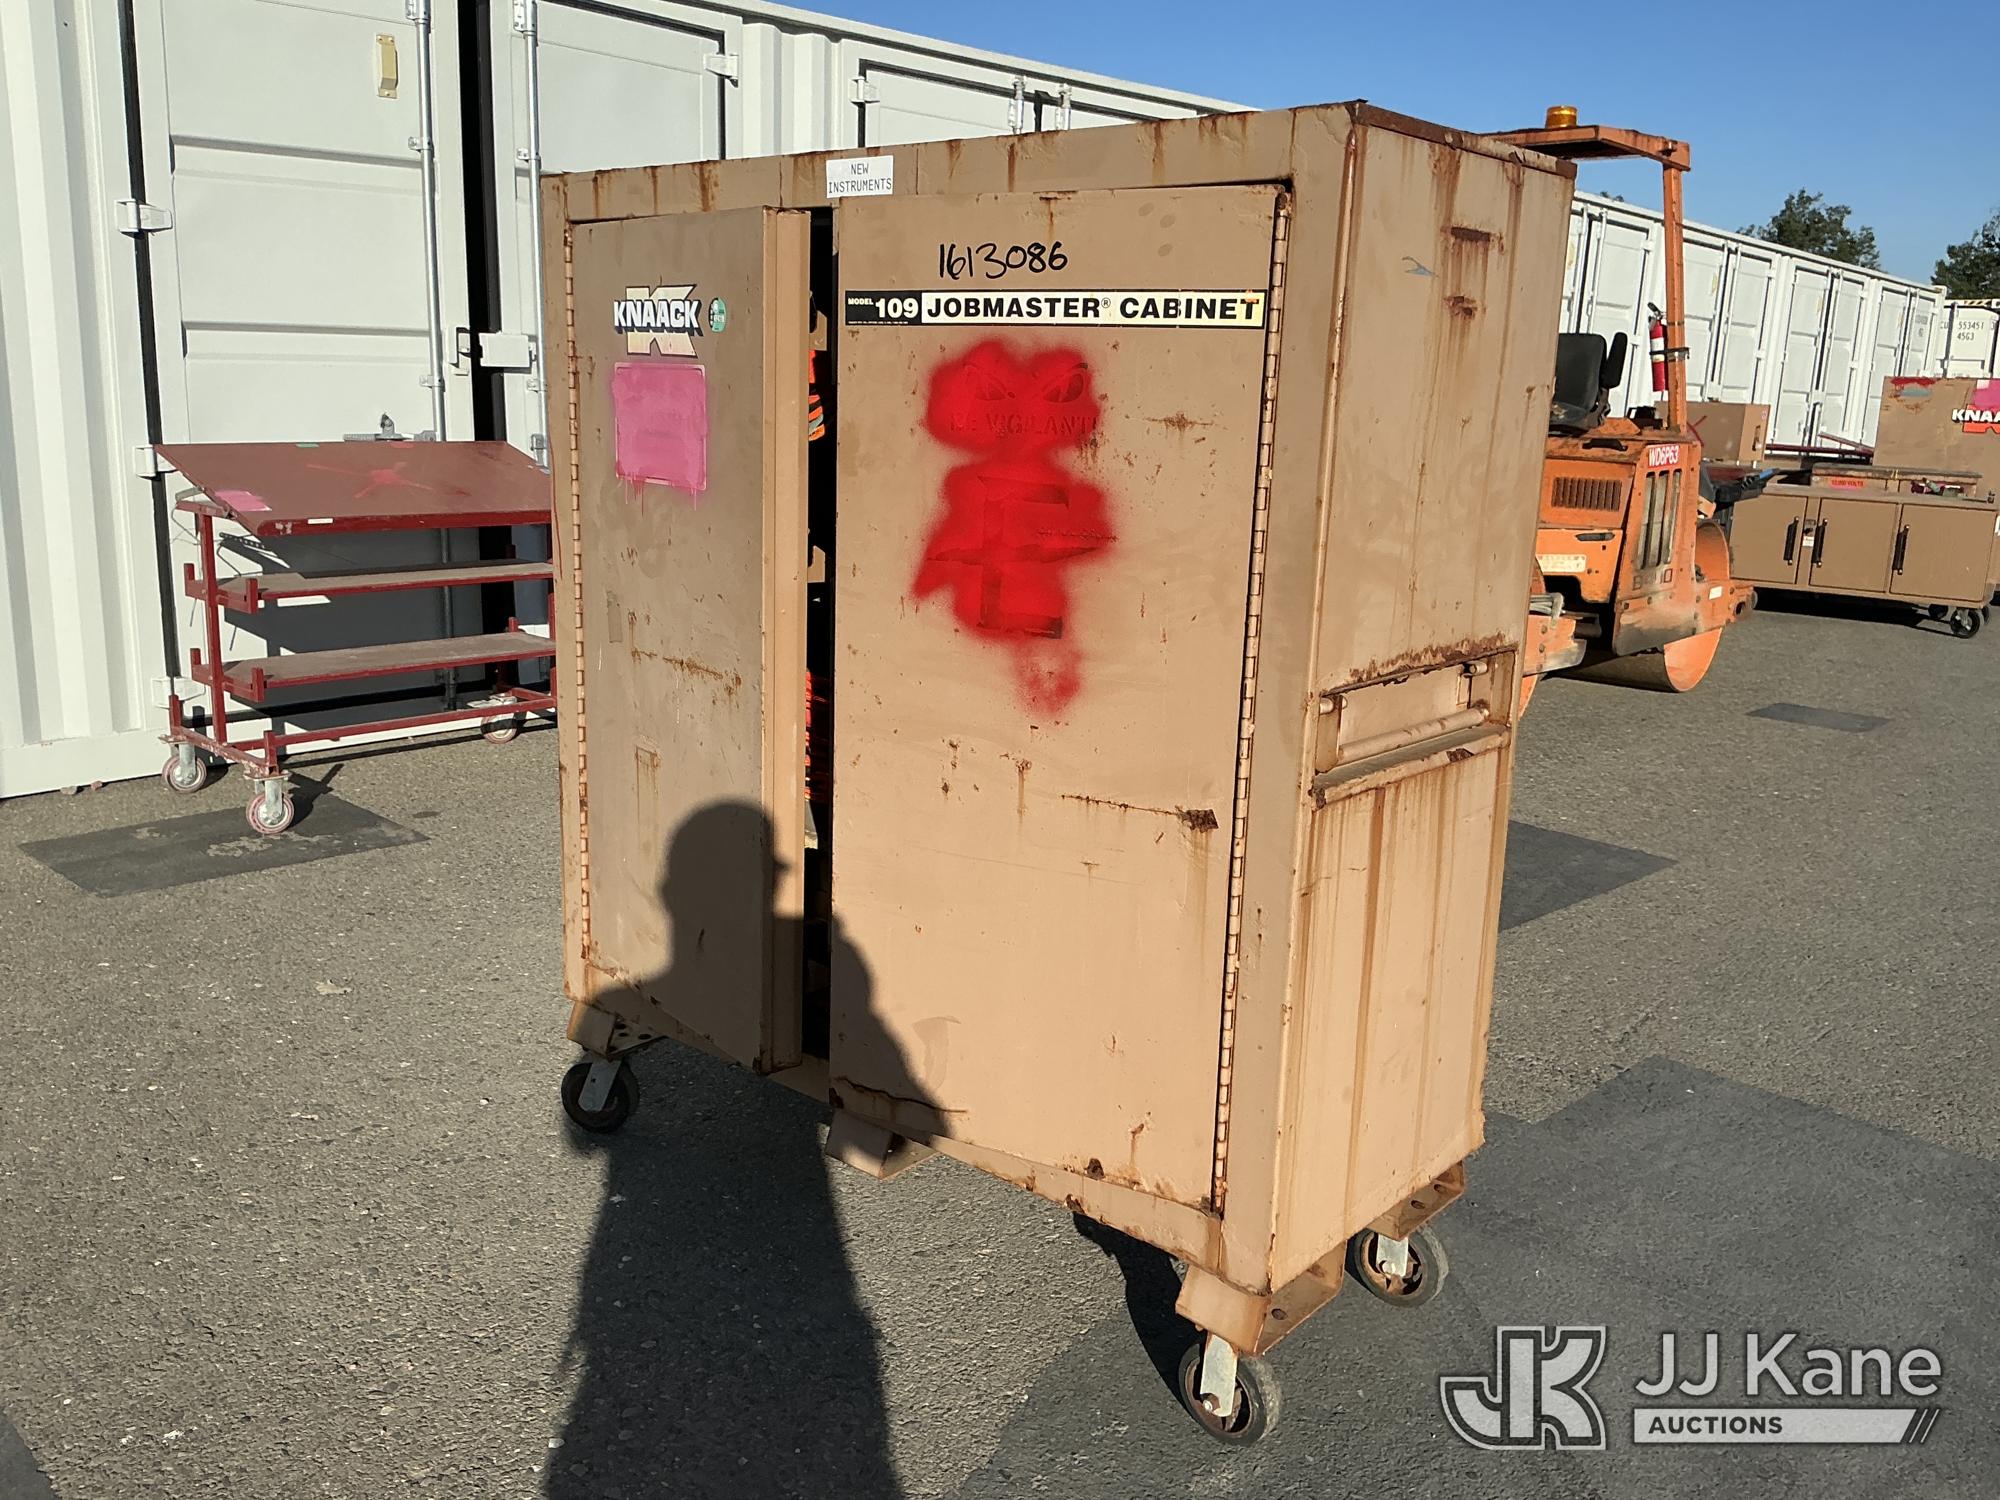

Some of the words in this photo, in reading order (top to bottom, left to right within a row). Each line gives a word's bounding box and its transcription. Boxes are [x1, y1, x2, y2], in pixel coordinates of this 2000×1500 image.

[850, 162, 869, 175] NEW
[828, 177, 892, 194] INSTRUMENTS
[939, 241, 1068, 280] 1613086
[613, 299, 701, 333] KNAACK
[847, 297, 874, 306] MODEL
[875, 297, 919, 319] 109
[1119, 297, 1260, 320] CABINET
